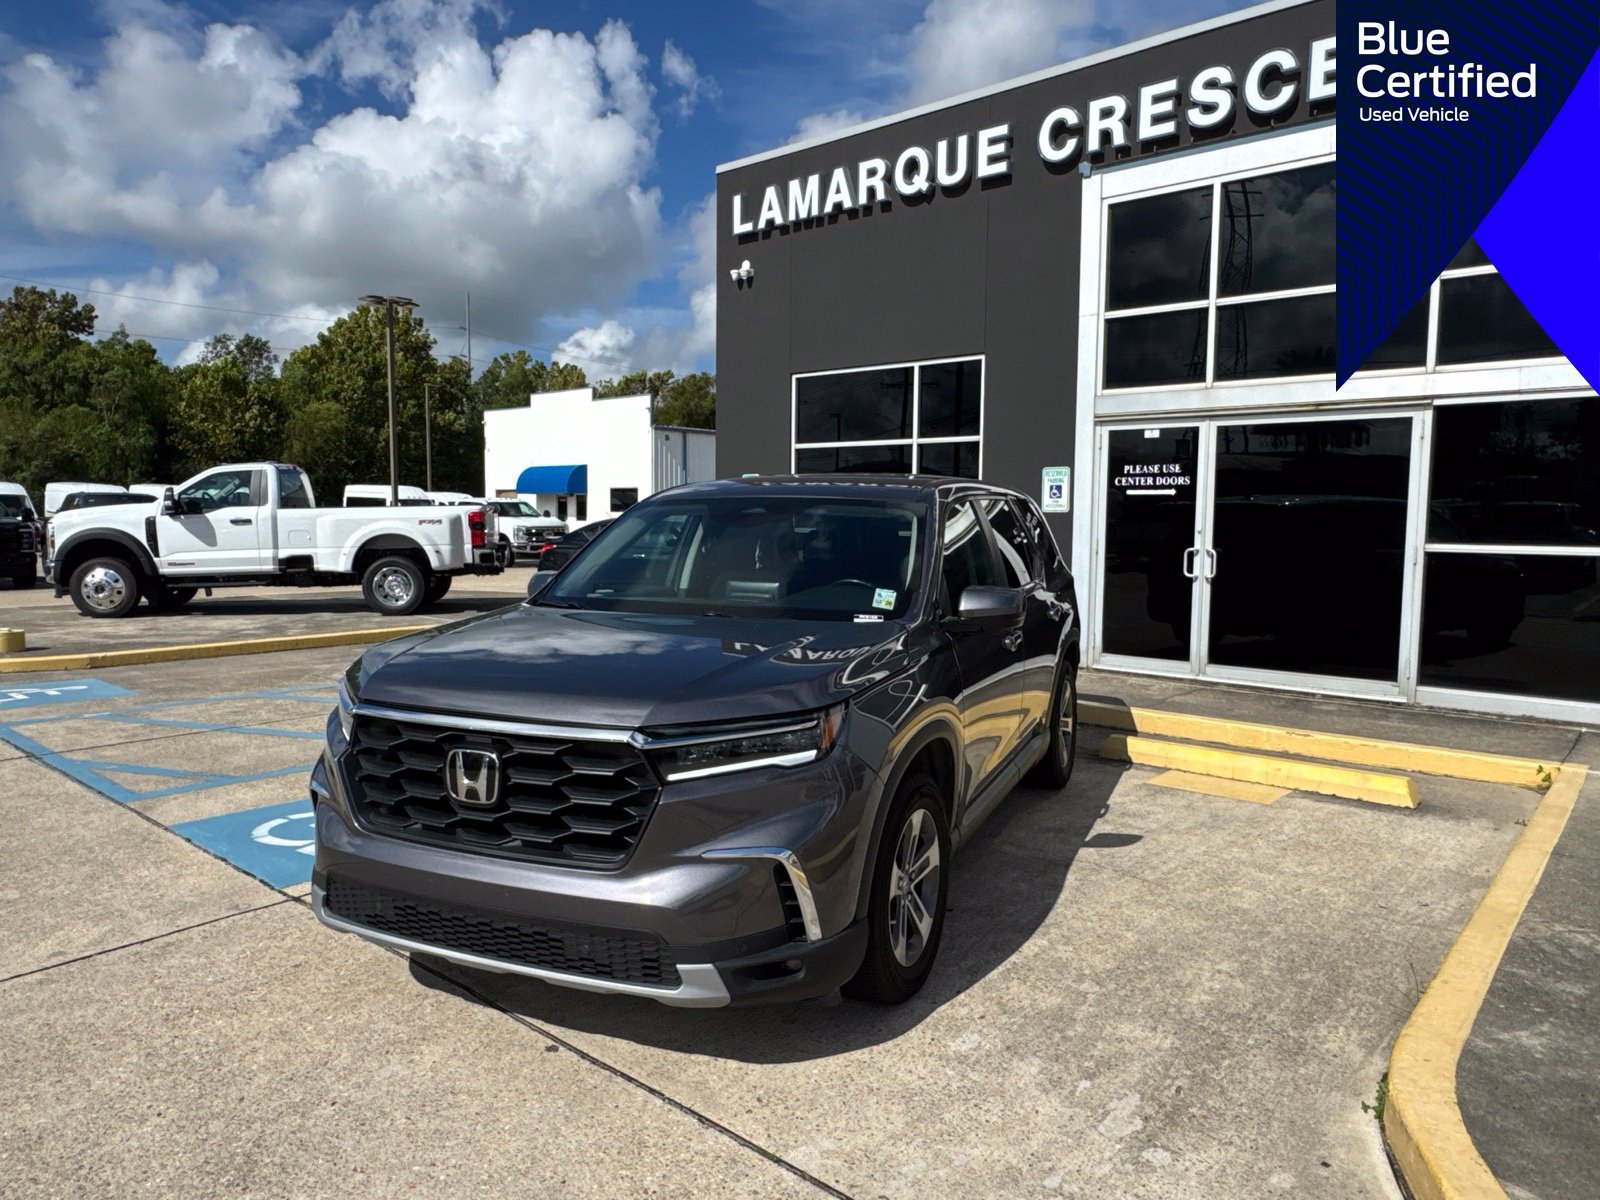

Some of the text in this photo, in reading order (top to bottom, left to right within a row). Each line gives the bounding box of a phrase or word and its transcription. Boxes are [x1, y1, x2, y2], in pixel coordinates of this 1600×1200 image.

[731, 123, 1011, 237] LAMARQUE
[1123, 463, 1182, 475] PLEASE USE
[1114, 475, 1191, 487] CENTER DOORS
